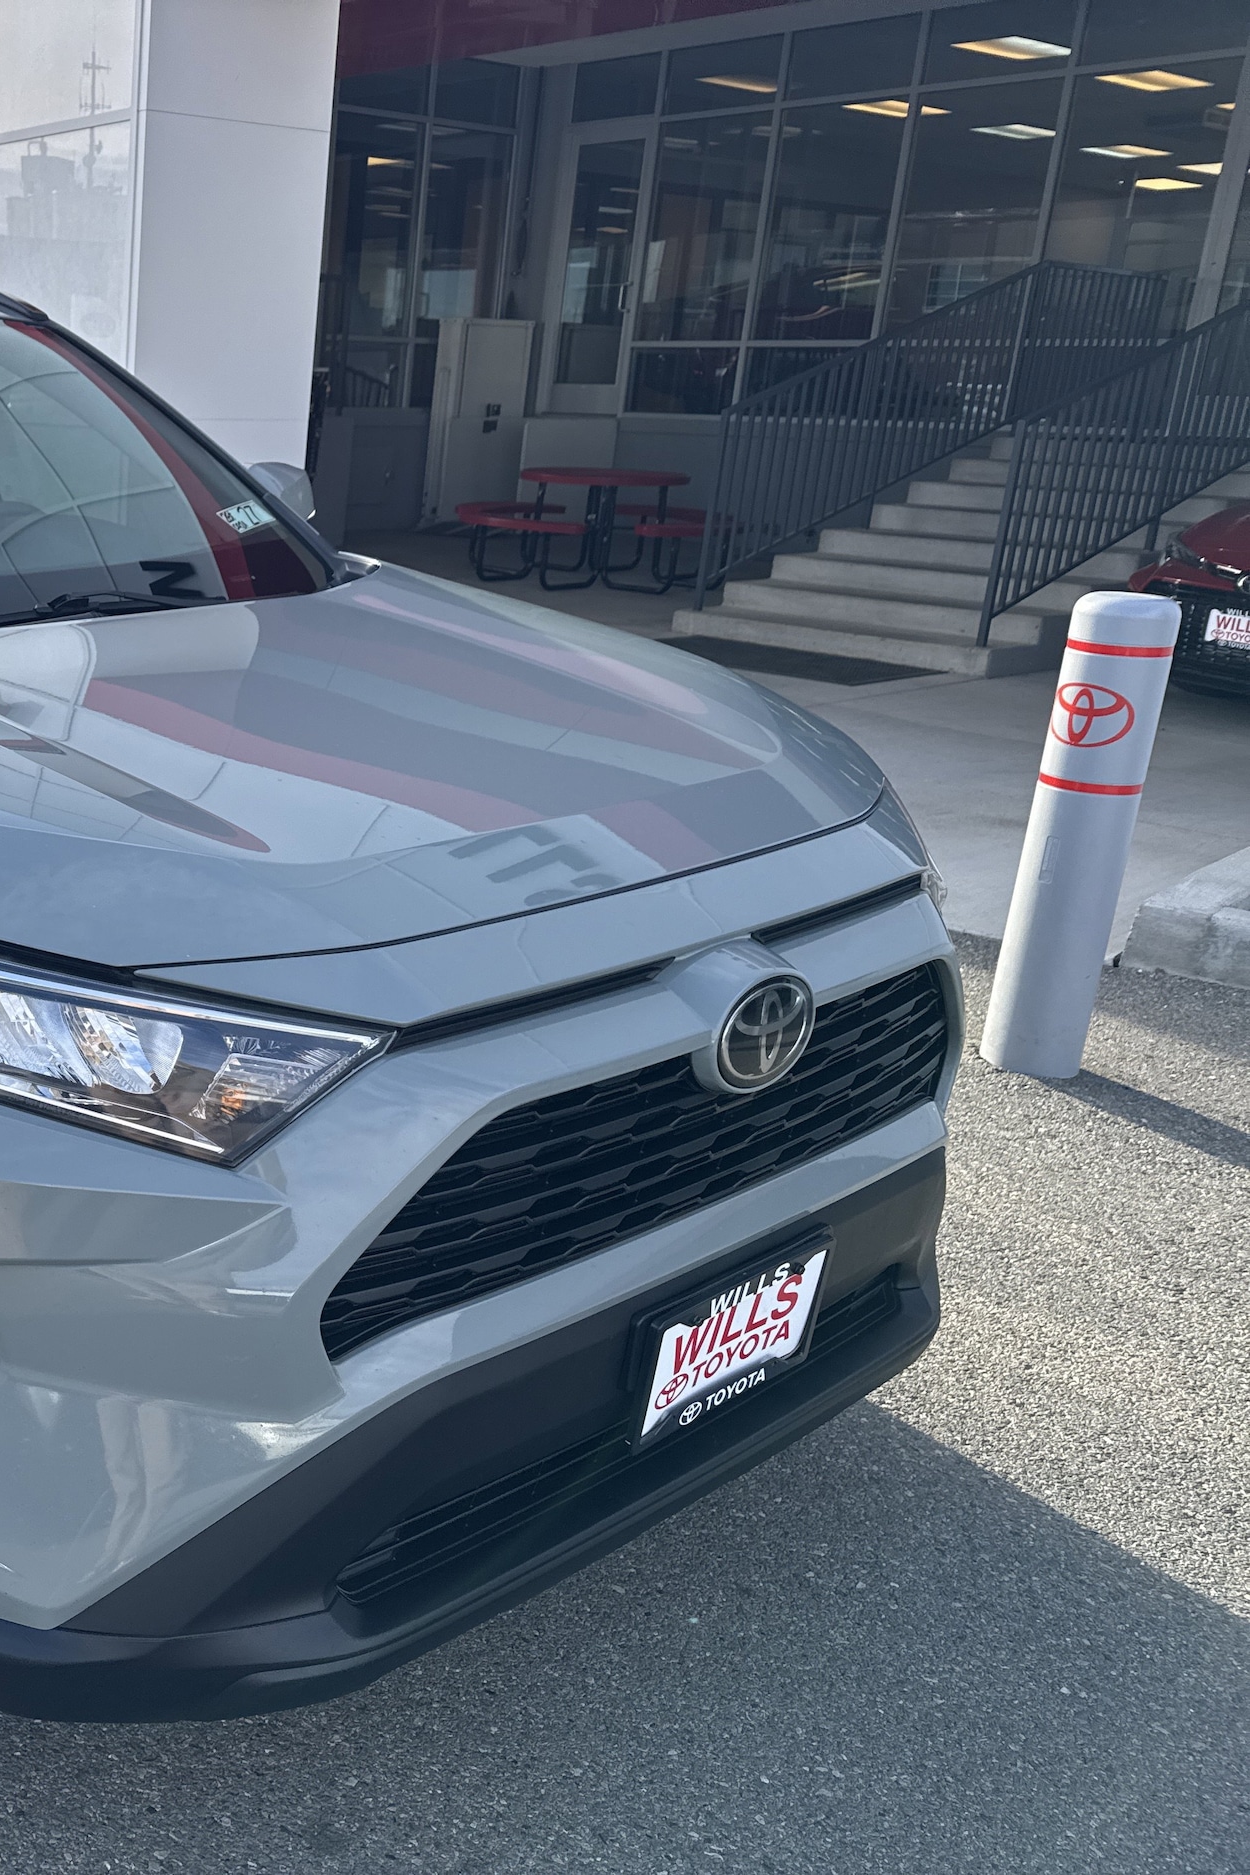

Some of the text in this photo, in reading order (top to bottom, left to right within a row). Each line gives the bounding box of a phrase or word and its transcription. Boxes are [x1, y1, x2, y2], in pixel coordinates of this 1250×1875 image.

[710, 1262, 791, 1317] WILLS
[673, 1273, 803, 1375] WILLS
[692, 1319, 790, 1388] TOYOTA
[705, 1368, 766, 1411] TOYOTA
